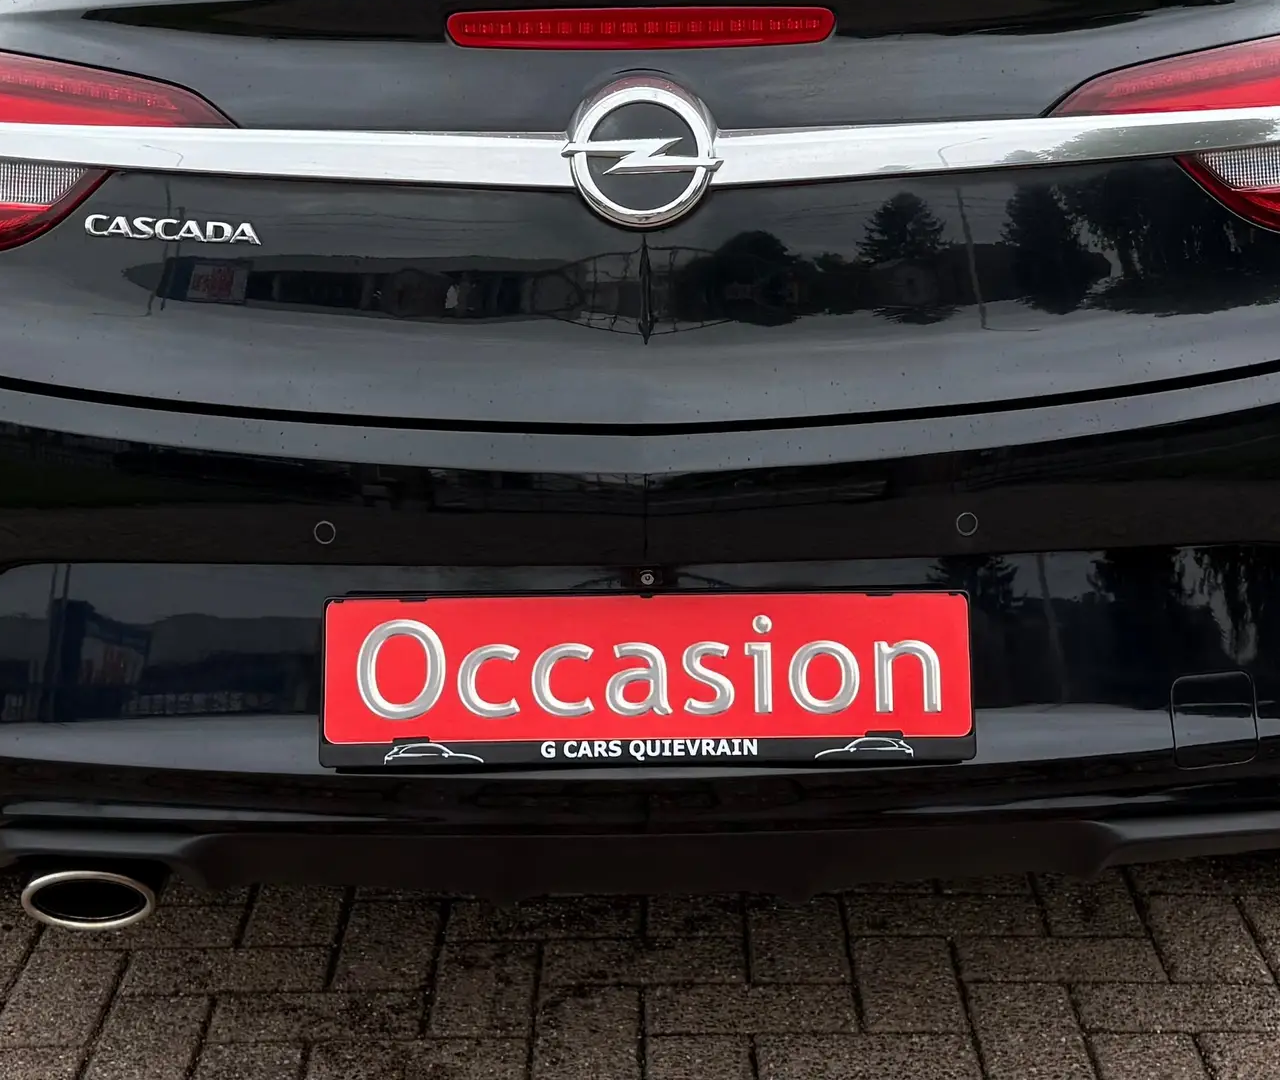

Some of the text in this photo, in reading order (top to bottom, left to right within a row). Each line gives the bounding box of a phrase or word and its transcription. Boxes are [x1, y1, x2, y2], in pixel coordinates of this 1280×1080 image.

[84, 213, 262, 246] CASCADA
[356, 614, 942, 720] Occasion
[540, 737, 759, 761] G CARS QUIEVRAIN
